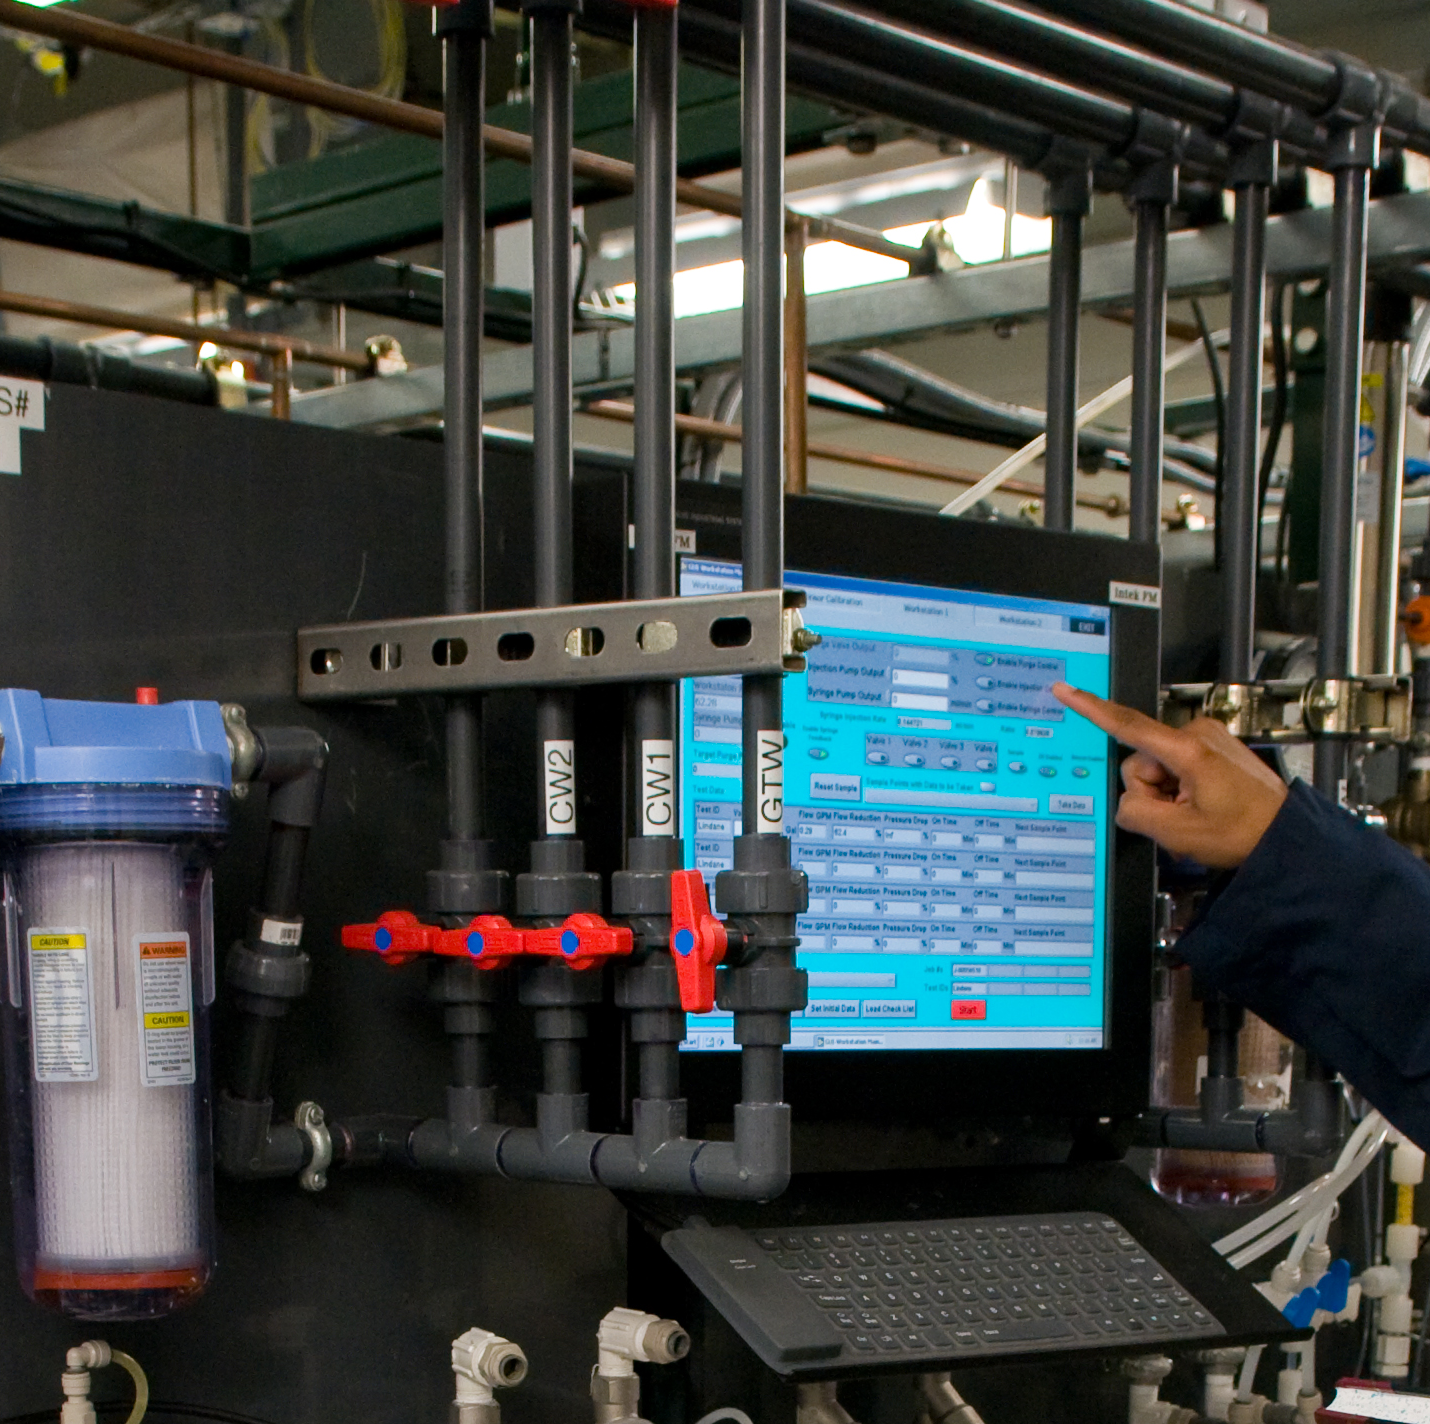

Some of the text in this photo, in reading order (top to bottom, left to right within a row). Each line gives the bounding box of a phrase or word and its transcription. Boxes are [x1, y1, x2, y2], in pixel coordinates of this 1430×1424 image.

[1114, 587, 1139, 601] Intek
[761, 738, 783, 823] GTW
[547, 749, 573, 825] CW2
[645, 754, 672, 826] CW1
[814, 782, 858, 794] Reset Sample
[696, 805, 720, 814] Test ID
[698, 821, 725, 831] Lindane
[696, 843, 720, 851] Test ID
[697, 859, 724, 868] Lindane
[39, 937, 70, 946] CAUTION
[810, 1004, 822, 1013] Set
[841, 1004, 856, 1013] Data
[866, 1004, 881, 1013] Load
[882, 1004, 902, 1013] Check
[959, 1006, 977, 1015] Start
[151, 1015, 185, 1025] CAUTION
